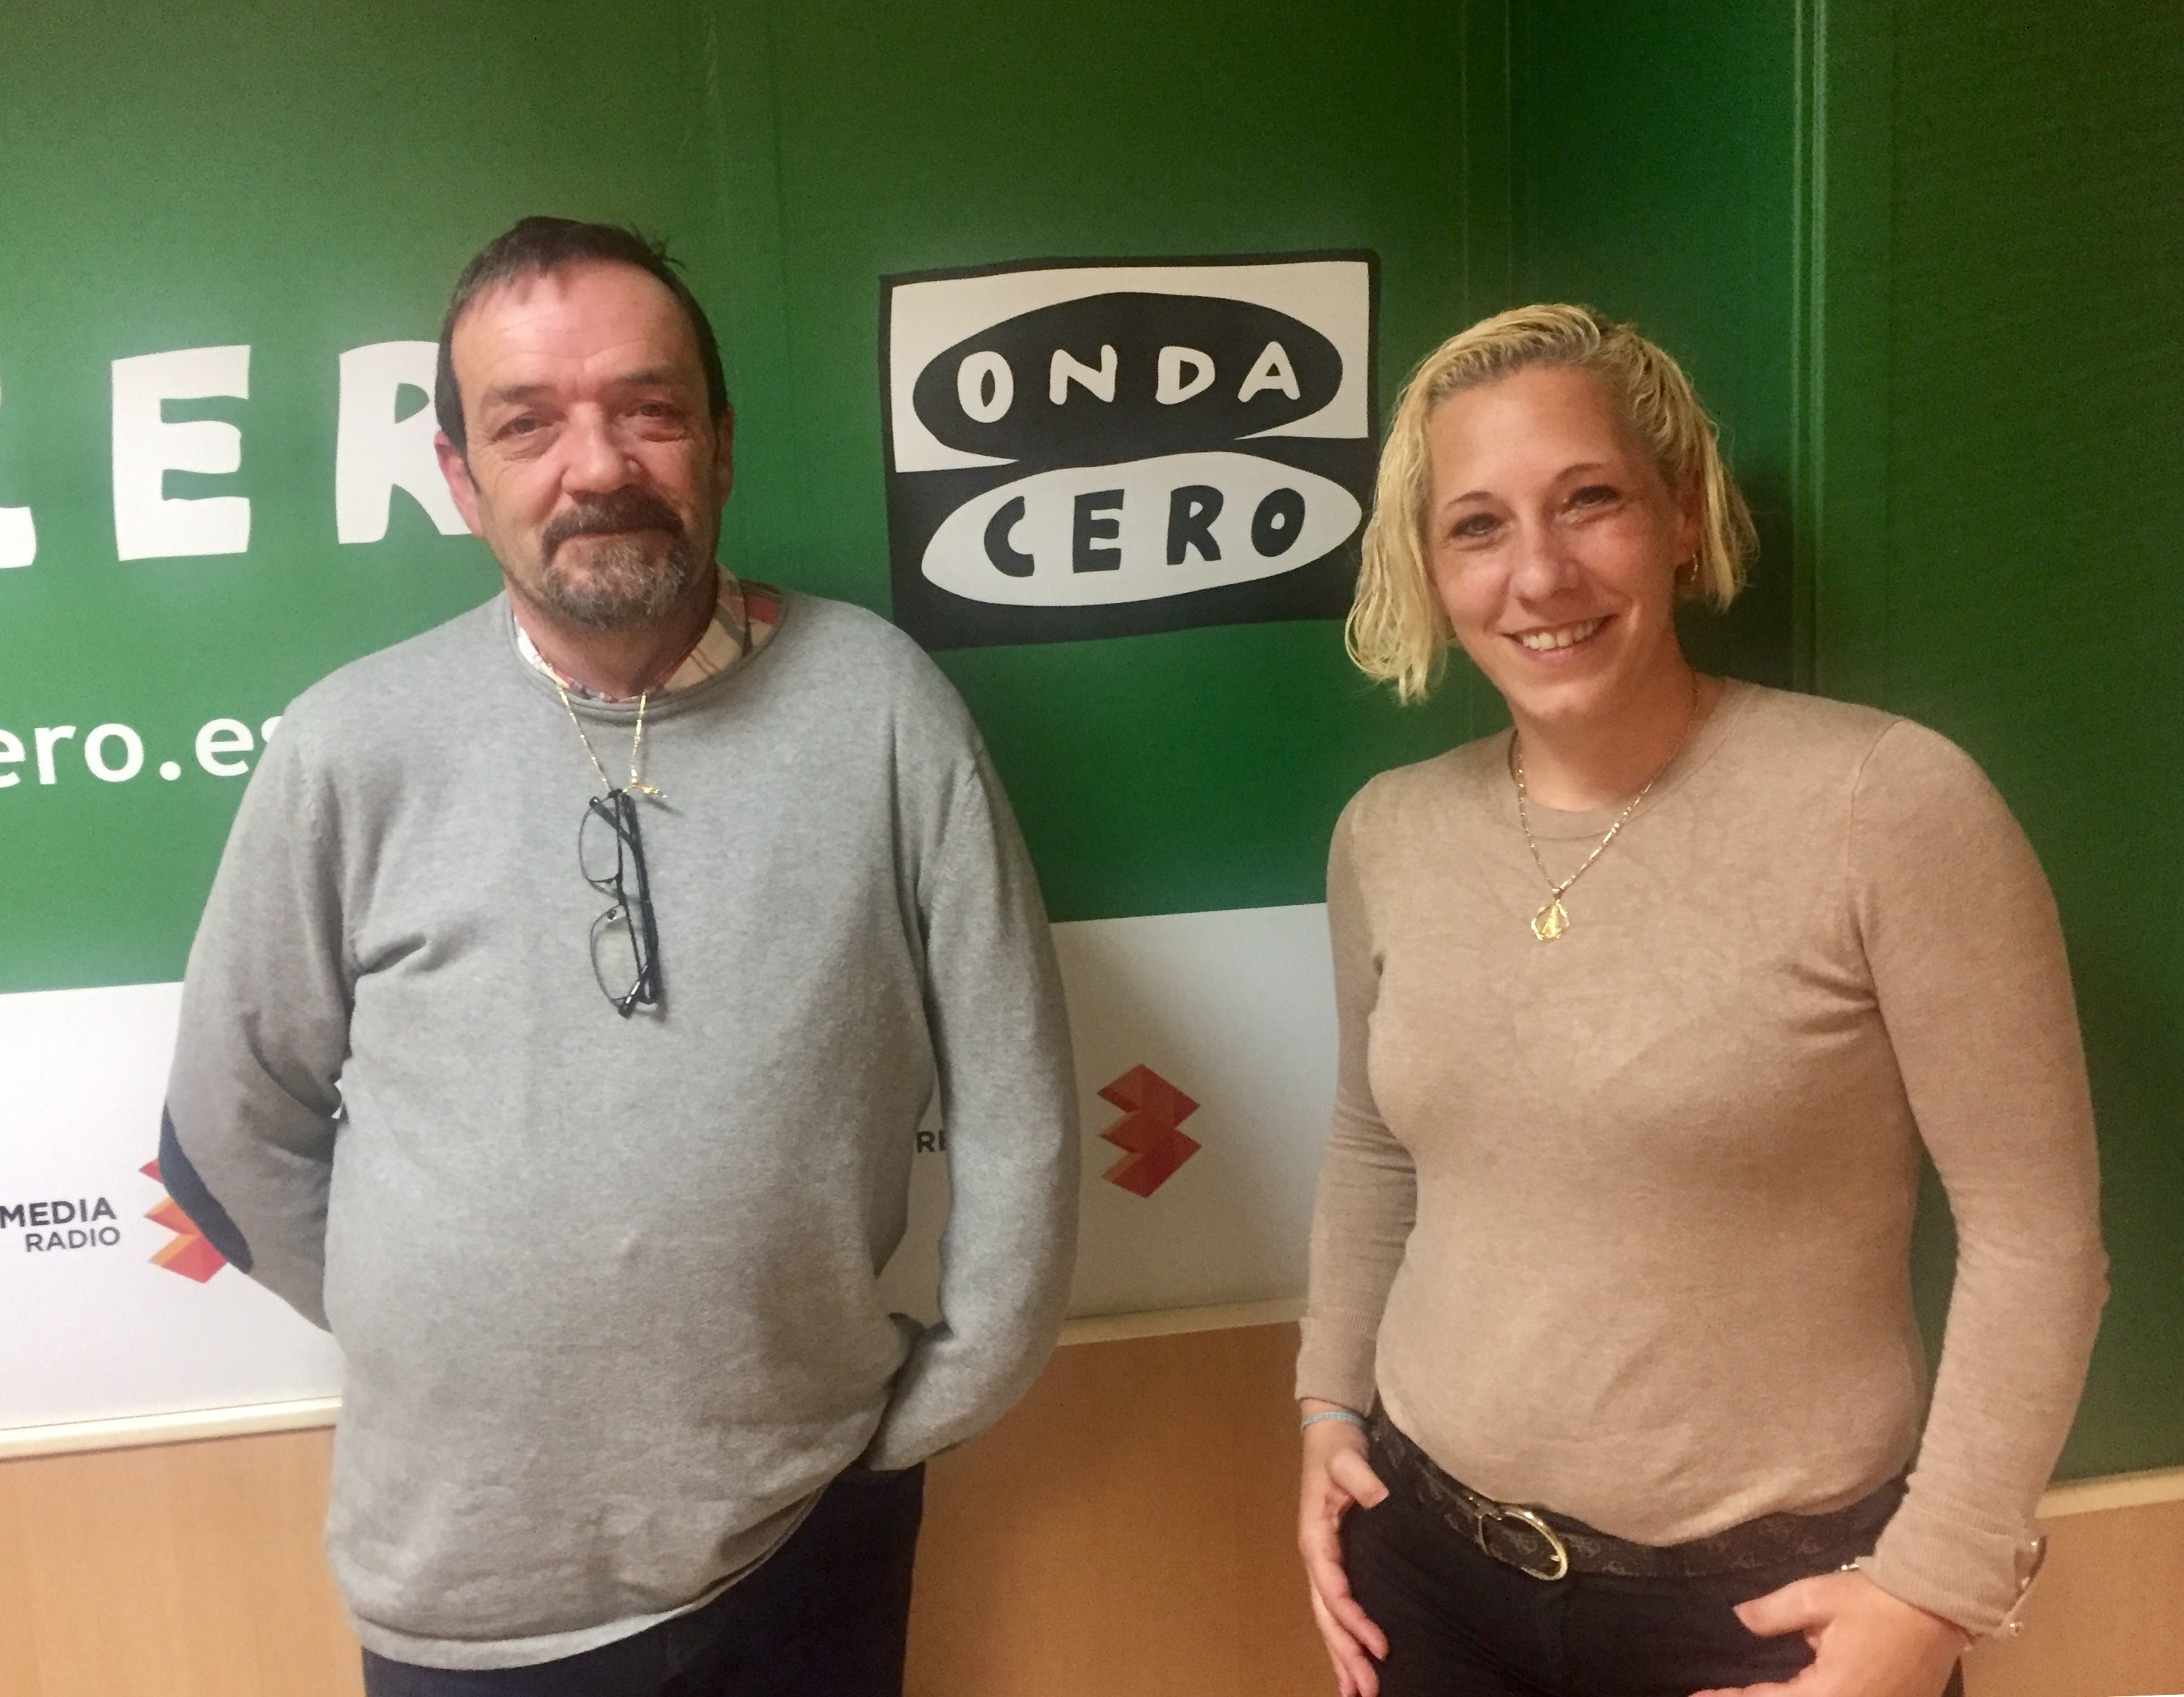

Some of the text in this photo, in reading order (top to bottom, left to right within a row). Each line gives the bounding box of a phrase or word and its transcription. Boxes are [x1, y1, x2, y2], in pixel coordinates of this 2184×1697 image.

[957, 341, 1300, 423] ONDA
[984, 485, 1305, 578] CERO
[0, 1197, 117, 1228] MEDIA
[25, 1226, 120, 1252] RADIO
